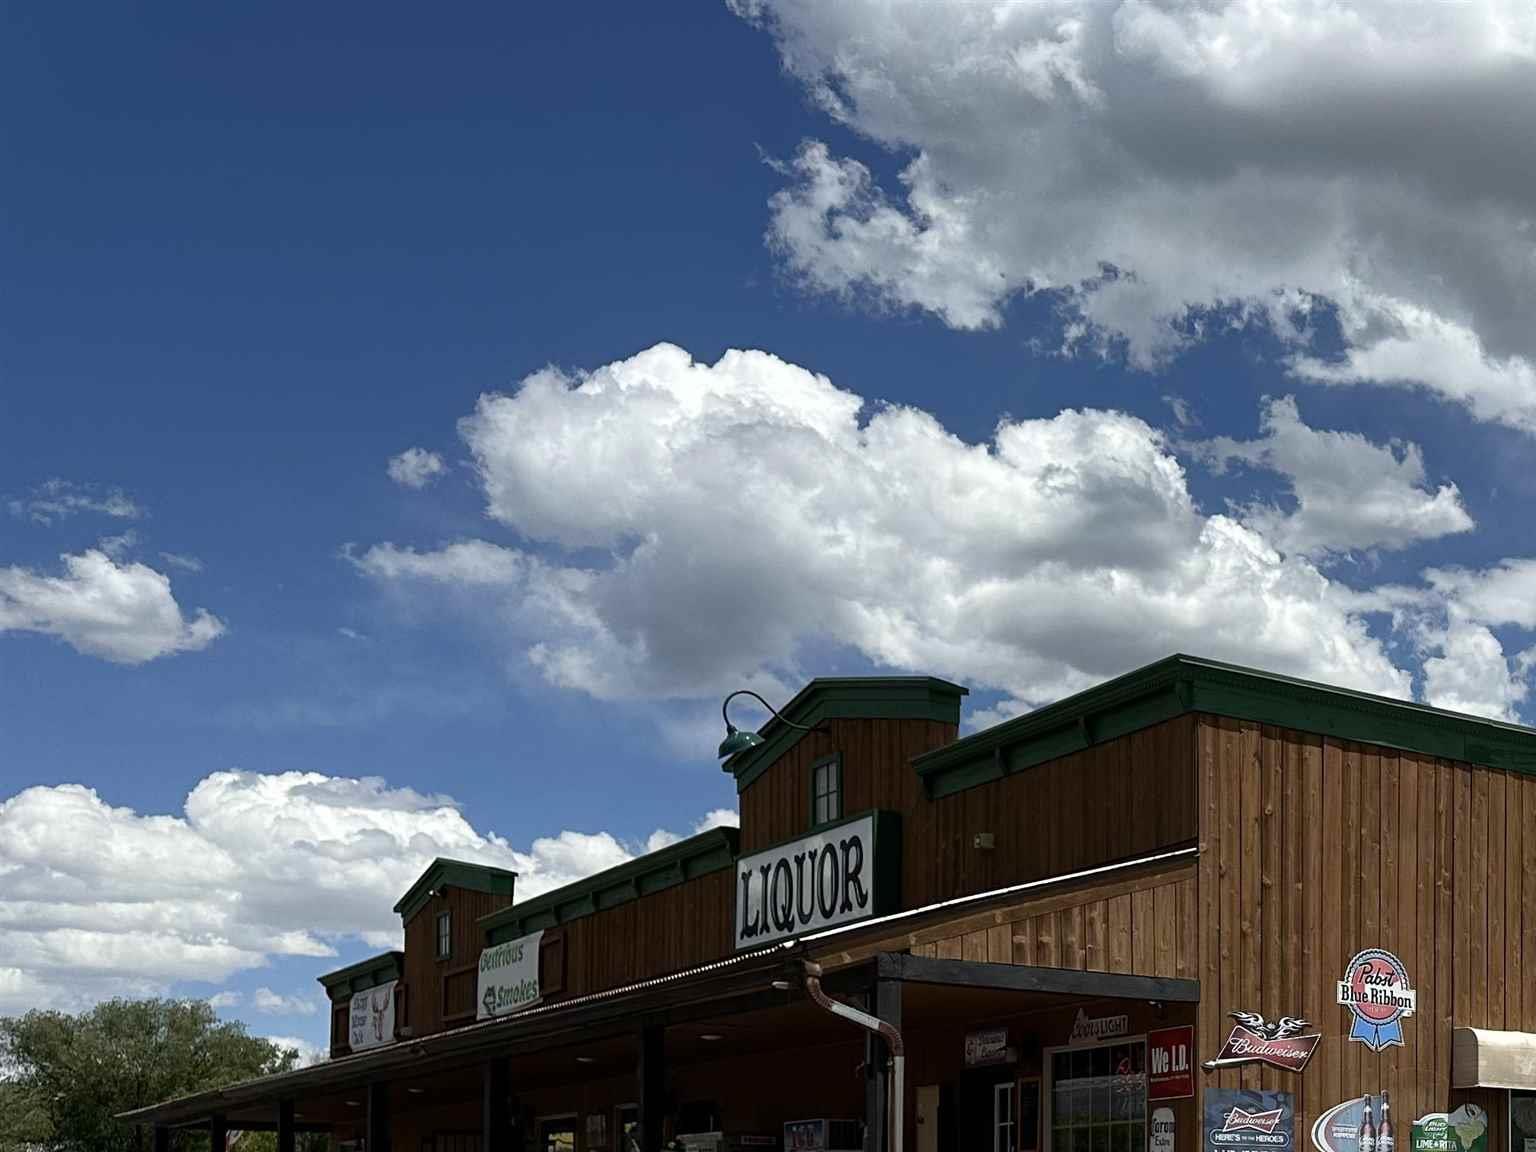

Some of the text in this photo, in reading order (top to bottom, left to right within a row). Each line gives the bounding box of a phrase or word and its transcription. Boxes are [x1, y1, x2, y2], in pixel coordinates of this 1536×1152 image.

[739, 834, 868, 939] LIQUOR
[1358, 962, 1396, 988] Pabst
[496, 979, 538, 1008] Smokes
[1341, 984, 1412, 1009] Blue Ribbon
[1151, 1043, 1189, 1074] We I.D.
[1229, 1037, 1309, 1059] Budweiser
[1224, 1112, 1280, 1125] Budweiser
